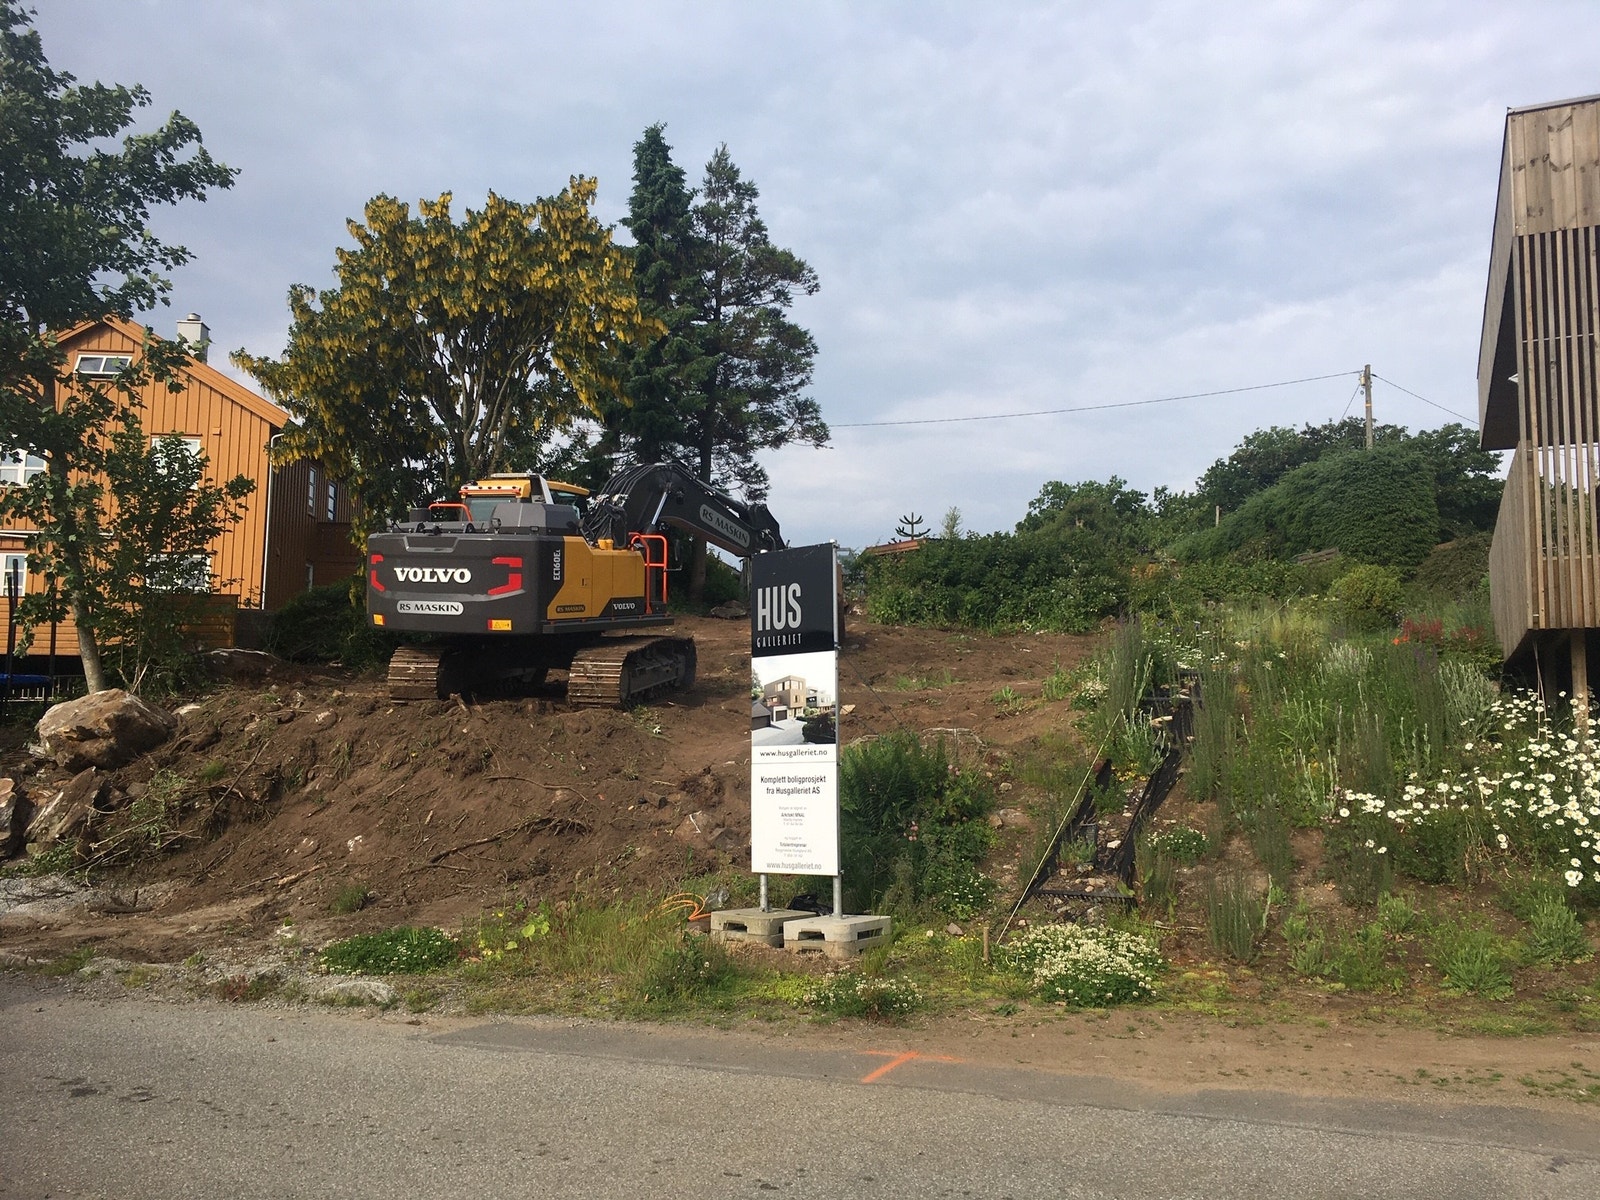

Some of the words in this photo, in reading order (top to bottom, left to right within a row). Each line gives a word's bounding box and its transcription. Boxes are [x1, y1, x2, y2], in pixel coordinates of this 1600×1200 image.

[702, 508, 714, 522] RS
[715, 517, 748, 544] MASKIN
[394, 567, 472, 584] VOLVO
[399, 603, 411, 611] RS
[414, 603, 460, 612] MASKIN
[757, 583, 802, 631] HUS
[756, 633, 802, 648] GALLERIET
[760, 748, 828, 758] www.husgalleriet.no
[760, 775, 786, 785] Komplett
[787, 775, 827, 785] boligprosjekt
[766, 787, 775, 795] fra
[776, 786, 811, 796] Husgalleriet
[812, 786, 820, 794] AS
[766, 862, 822, 871] www.husgalleriet.no
